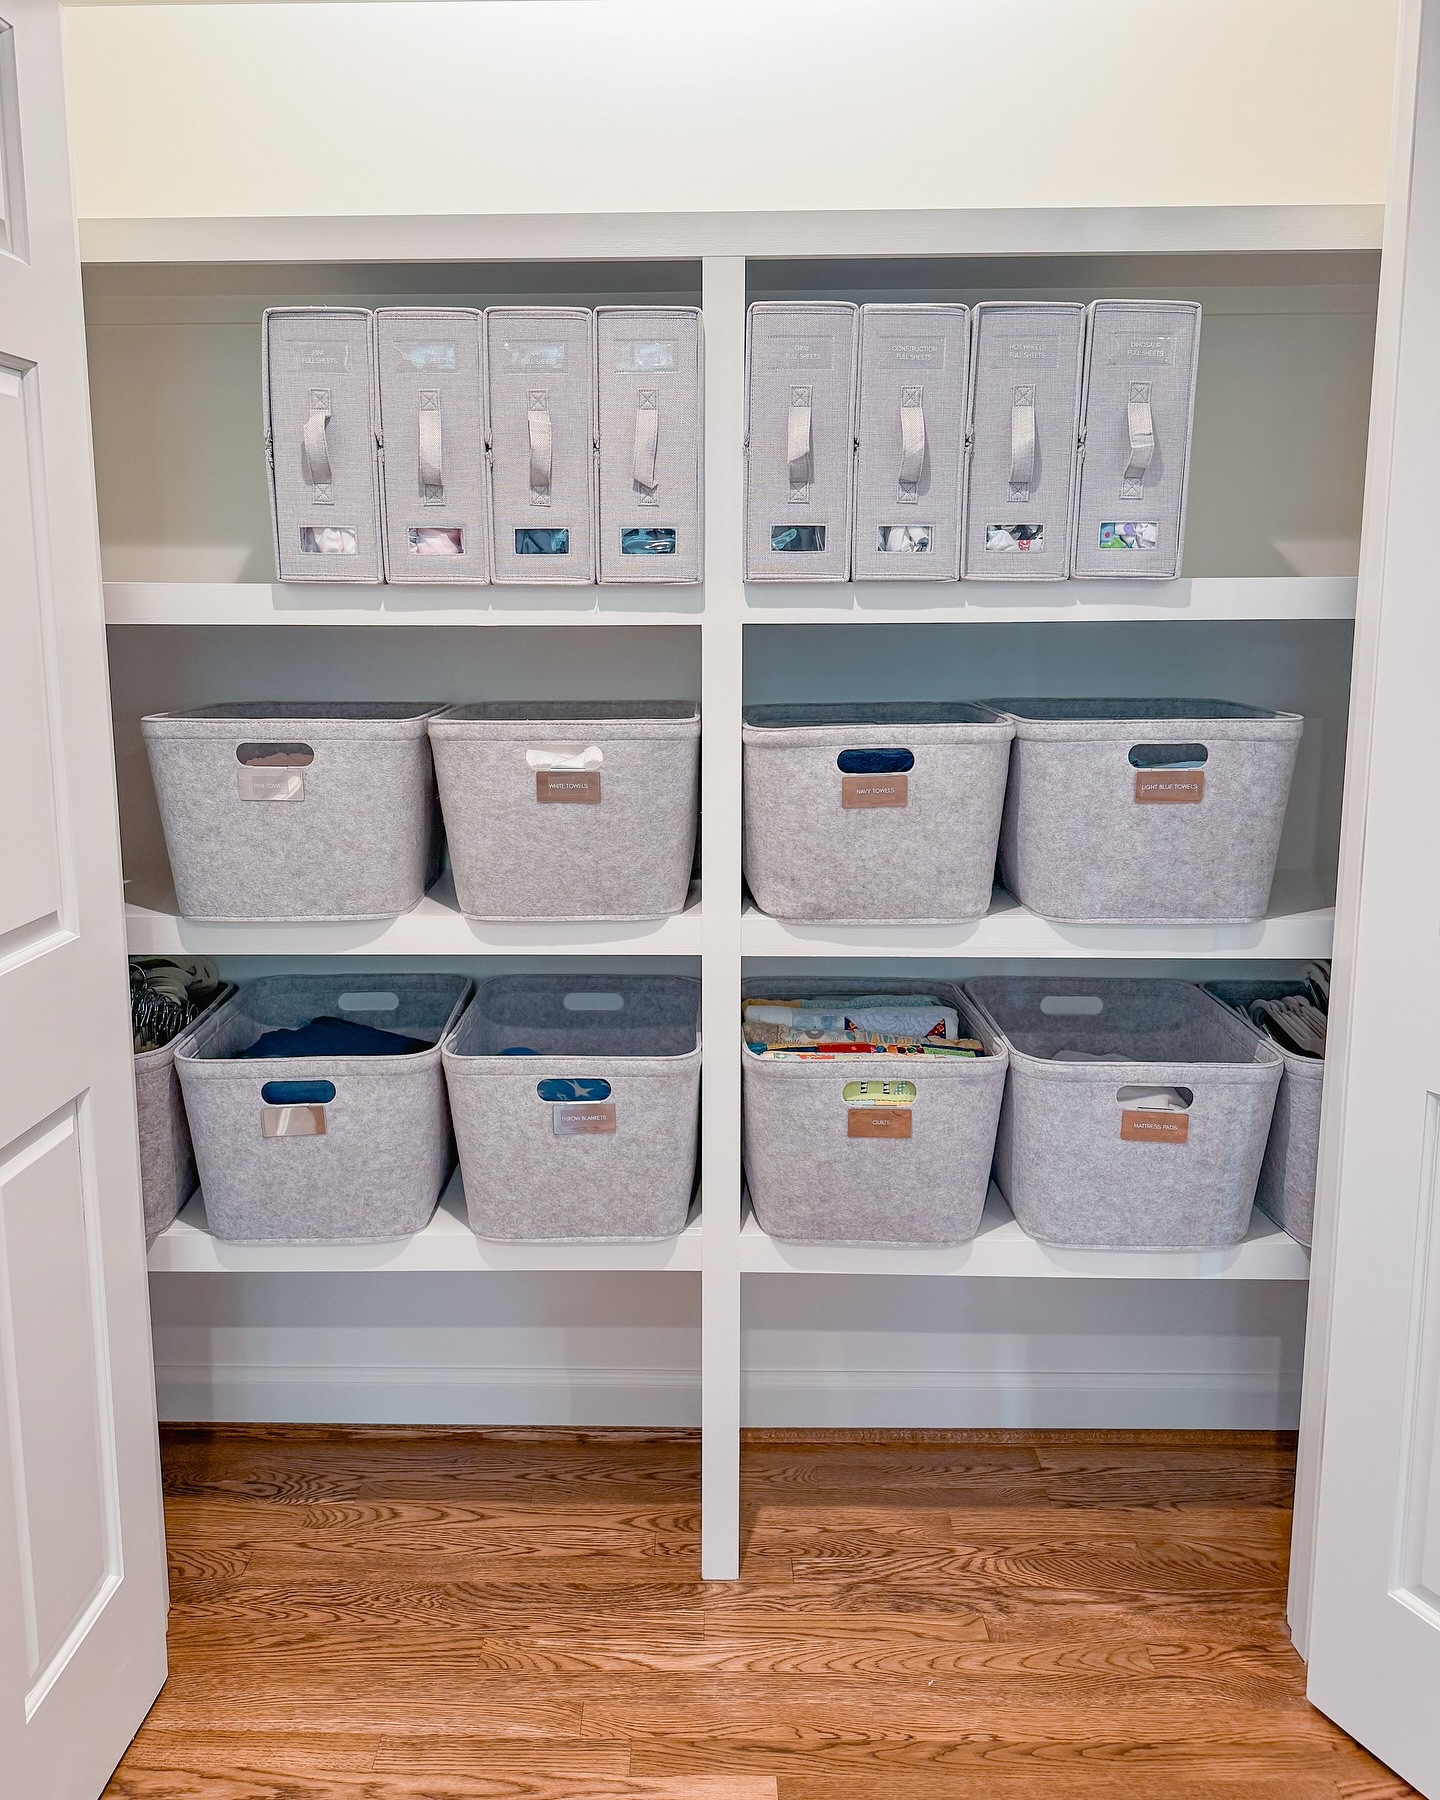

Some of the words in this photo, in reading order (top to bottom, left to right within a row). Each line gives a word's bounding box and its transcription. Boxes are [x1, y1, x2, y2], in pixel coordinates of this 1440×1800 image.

[909, 353, 932, 361] SHEETS
[1023, 351, 1046, 359] SHEETS
[1141, 349, 1164, 357] SHEETS
